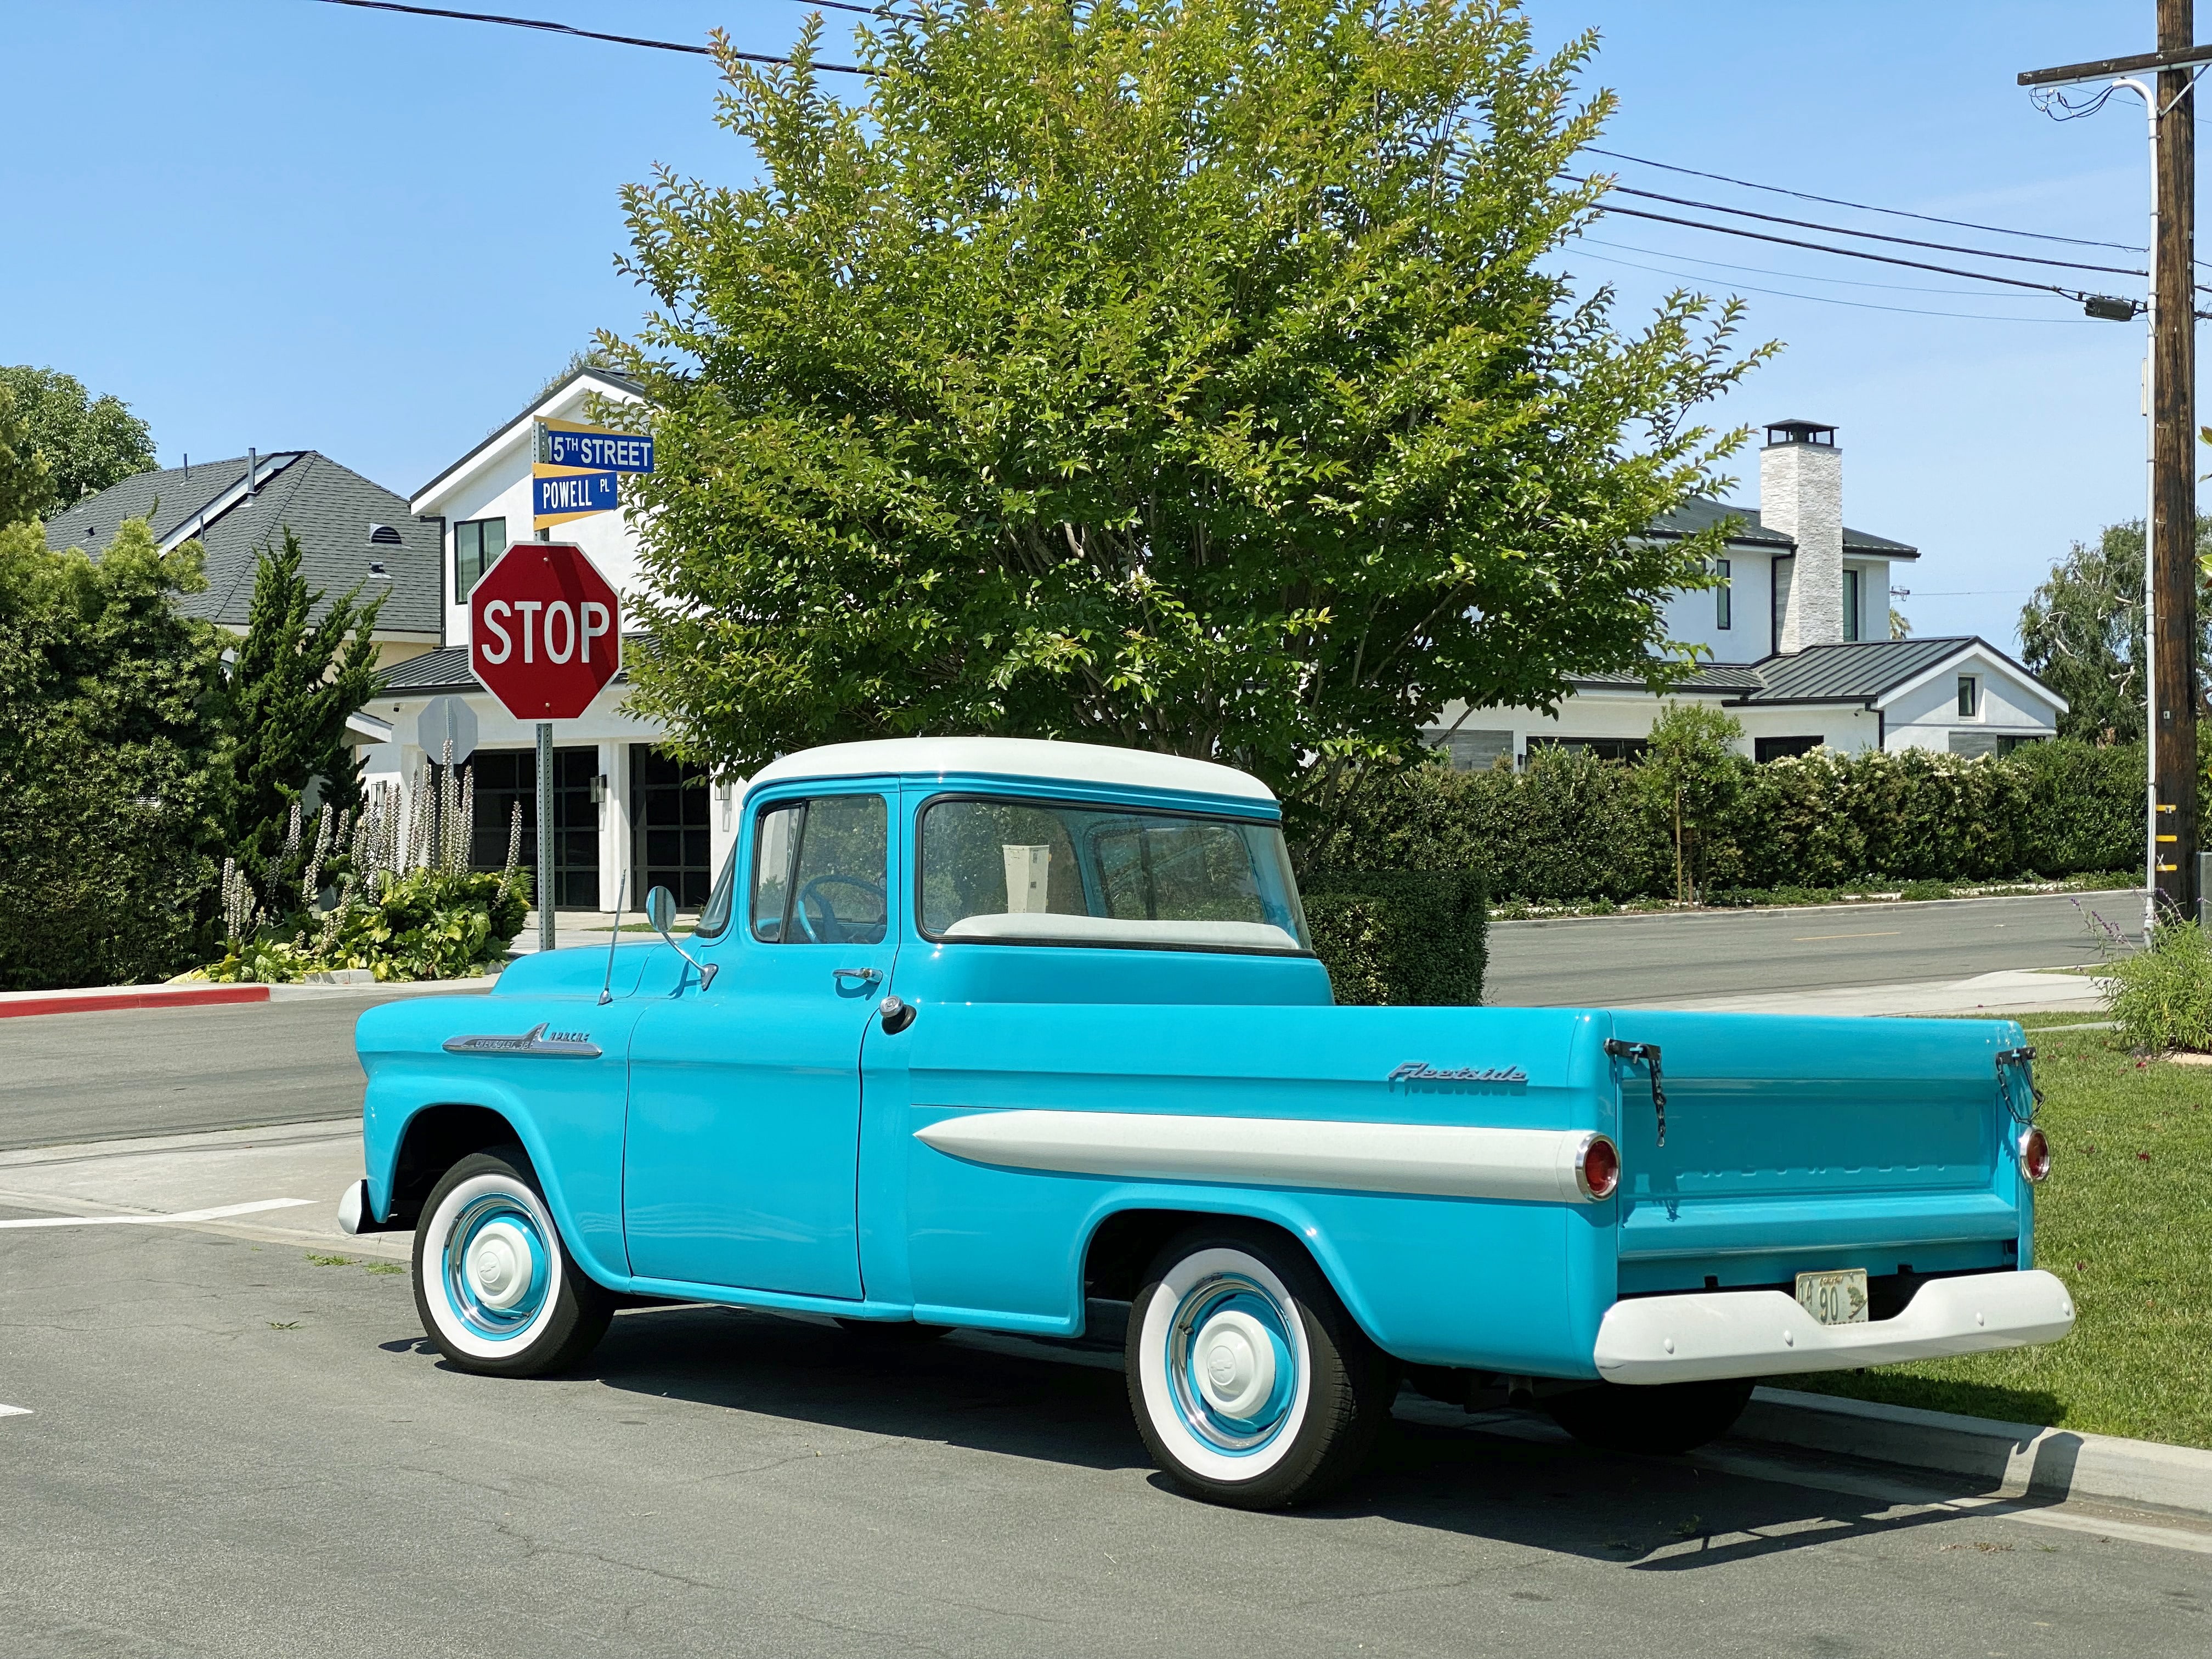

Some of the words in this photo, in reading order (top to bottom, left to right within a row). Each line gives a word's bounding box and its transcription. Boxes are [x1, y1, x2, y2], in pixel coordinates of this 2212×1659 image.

[548, 436, 579, 462] 15TH
[581, 438, 651, 466] STREET
[543, 479, 592, 509] POWELL
[600, 478, 610, 493] PL
[482, 600, 610, 665] STOP
[475, 1040, 516, 1049] CHEVROLET
[1389, 1062, 1528, 1082] Fleetside
[1819, 1286, 1838, 1323] 90
